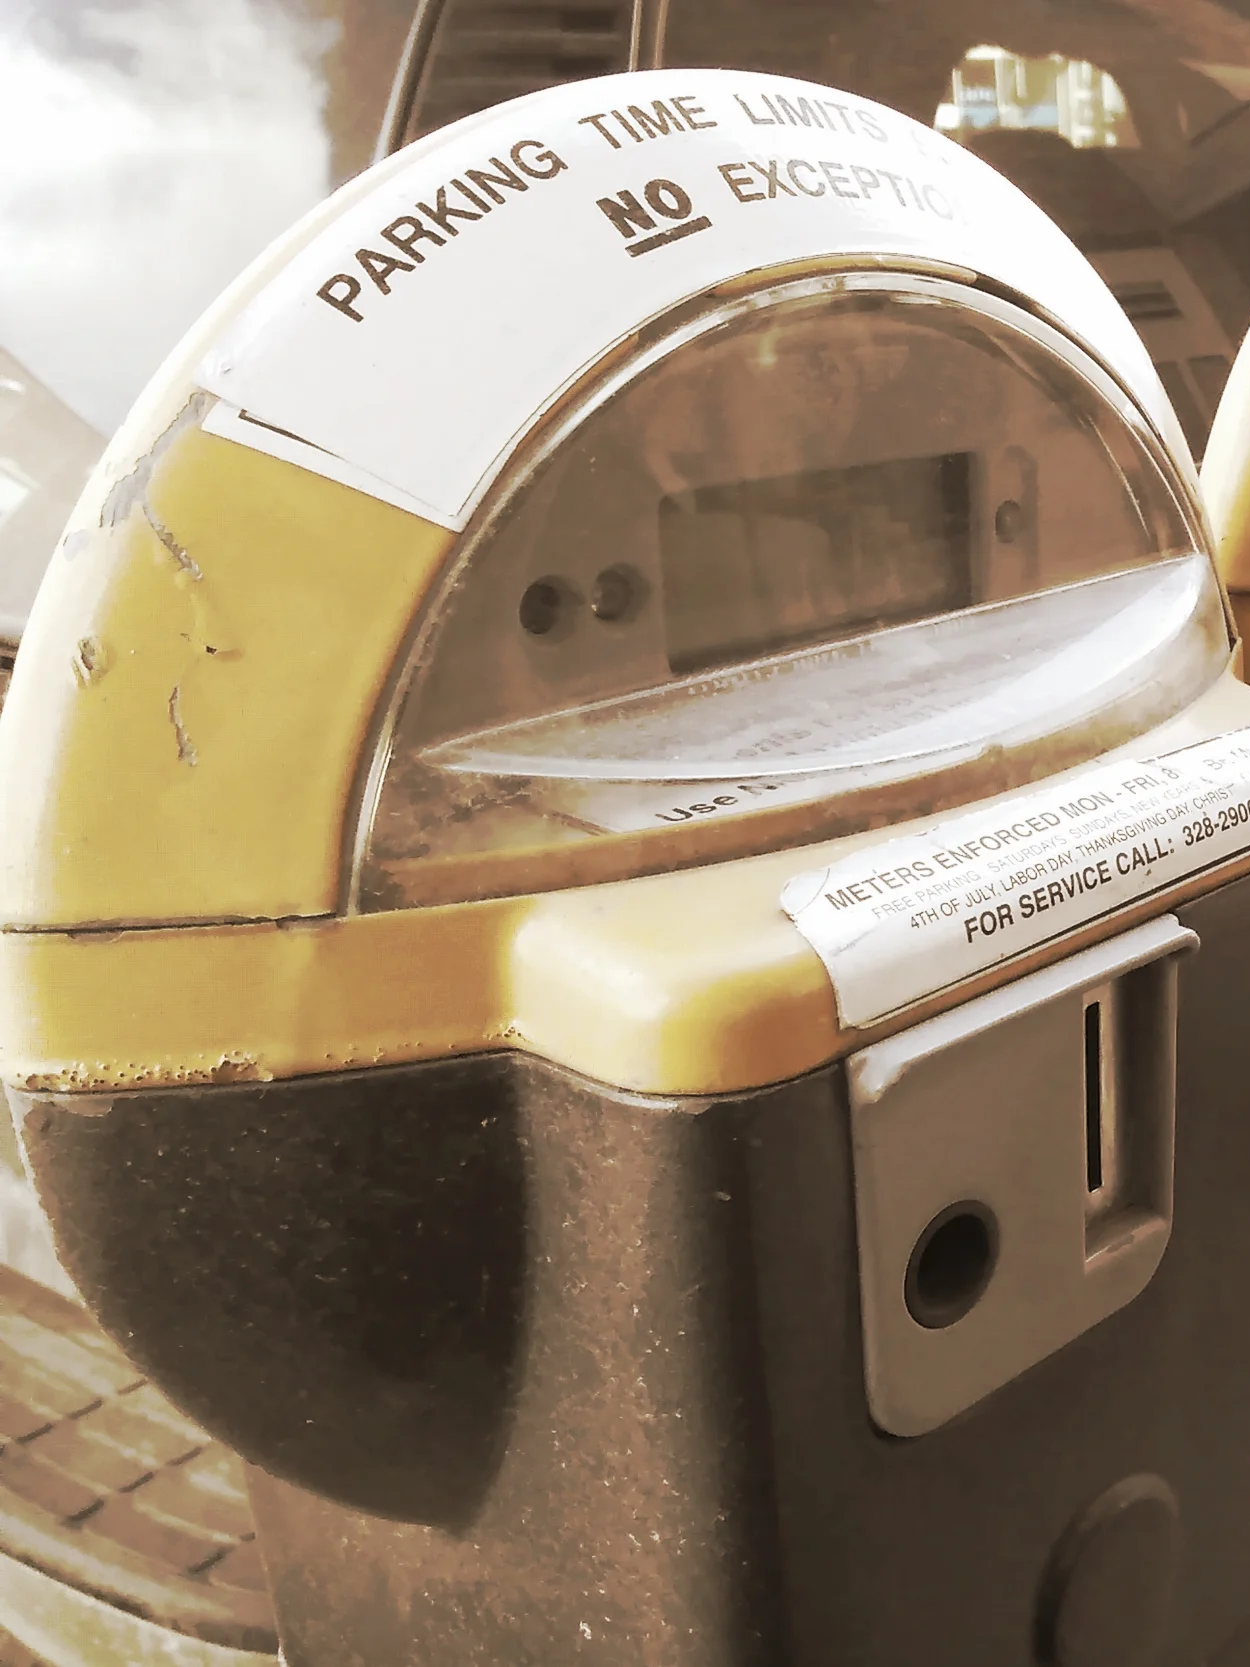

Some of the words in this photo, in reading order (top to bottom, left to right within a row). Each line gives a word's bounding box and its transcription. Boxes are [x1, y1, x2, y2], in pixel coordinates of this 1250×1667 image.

[316, 140, 568, 322] PARKING
[579, 95, 718, 149] TIME
[733, 94, 889, 143] LIMITS
[596, 178, 695, 239] NO
[718, 160, 969, 226] EXCEPTIO
[654, 793, 739, 822] Use
[824, 860, 935, 911] METERS
[932, 812, 1061, 870] ENFORCED
[1059, 791, 1115, 819] MON
[872, 896, 916, 920] FREE
[1131, 797, 1160, 814] NEW
[910, 908, 940, 929] 4TH
[940, 898, 961, 916] OF
[965, 883, 1002, 908] JULY,
[1000, 864, 1048, 892] LABOR
[1047, 851, 1079, 872] DAY,
[1076, 813, 1167, 857] THANKSGIVING
[964, 904, 1014, 943] FOR
[1019, 860, 1112, 918] SERVICE
[1116, 837, 1175, 876] CALL:
